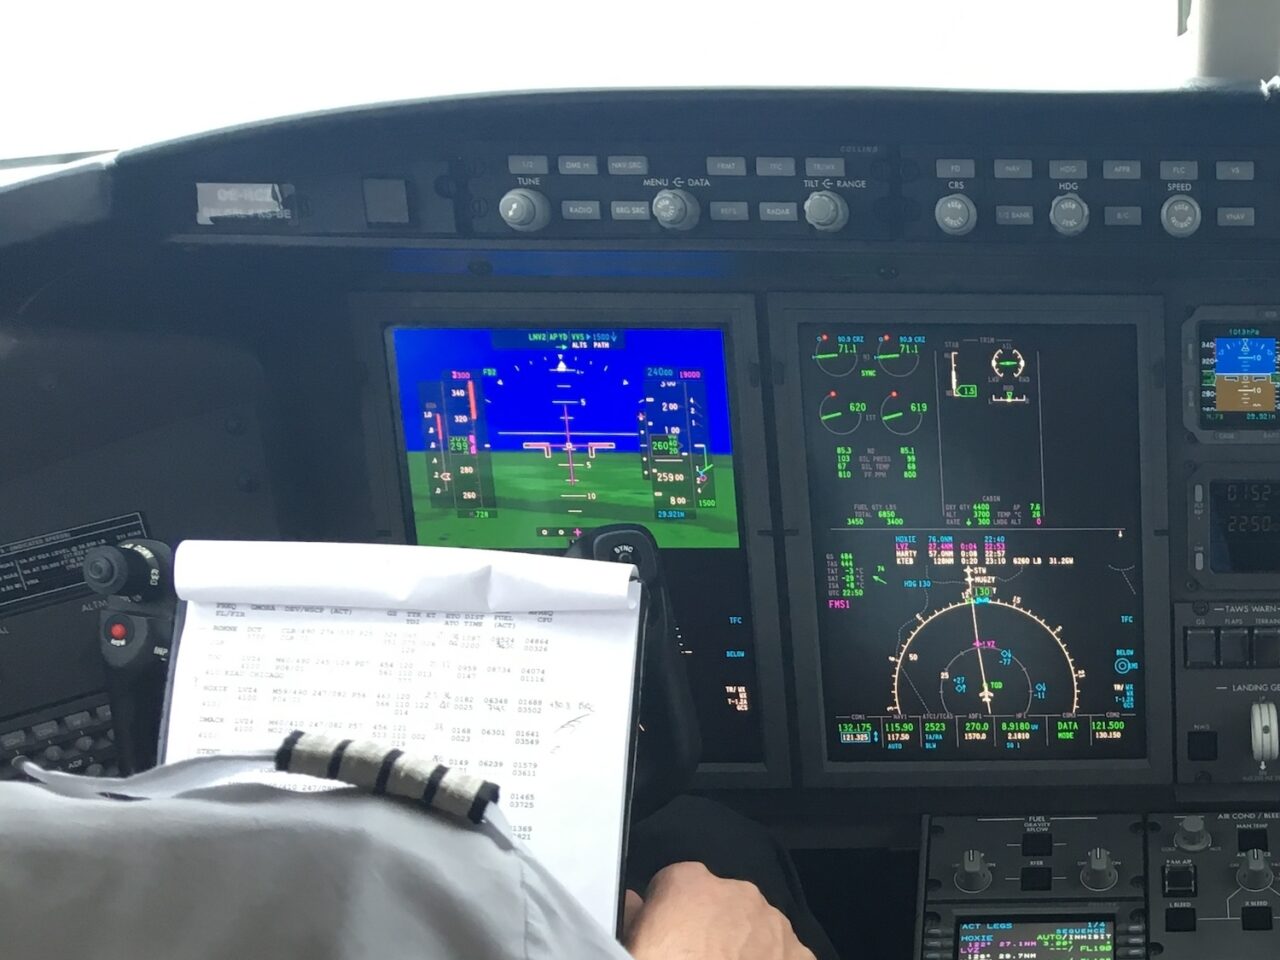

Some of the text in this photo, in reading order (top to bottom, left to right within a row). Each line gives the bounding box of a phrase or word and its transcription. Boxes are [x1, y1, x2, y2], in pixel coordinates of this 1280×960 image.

[517, 177, 540, 186] TUNE
[643, 178, 710, 187] MENU DATA
[803, 179, 866, 188] TILT RANGE
[948, 181, 965, 190] CRS
[1058, 182, 1079, 191] HDG
[1167, 182, 1191, 192] SPEED
[838, 344, 857, 354] 71.1
[899, 344, 919, 354] 71.1
[451, 389, 465, 397] 340
[849, 403, 866, 412] 620
[910, 403, 927, 412] 619
[454, 415, 468, 423] 320
[614, 544, 634, 554] SYNC
[829, 600, 850, 609] FMS1
[1225, 605, 1277, 613] TAWS WARN
[1232, 683, 1268, 693] LANDING
[838, 722, 872, 732] 132.175
[885, 722, 946, 732] 115.90 2523
[965, 721, 989, 731] 270.0
[1057, 721, 1079, 731] DATA
[1091, 721, 1125, 730] 121.500
[1217, 812, 1230, 820] AIR
[1231, 812, 1256, 820] COND
